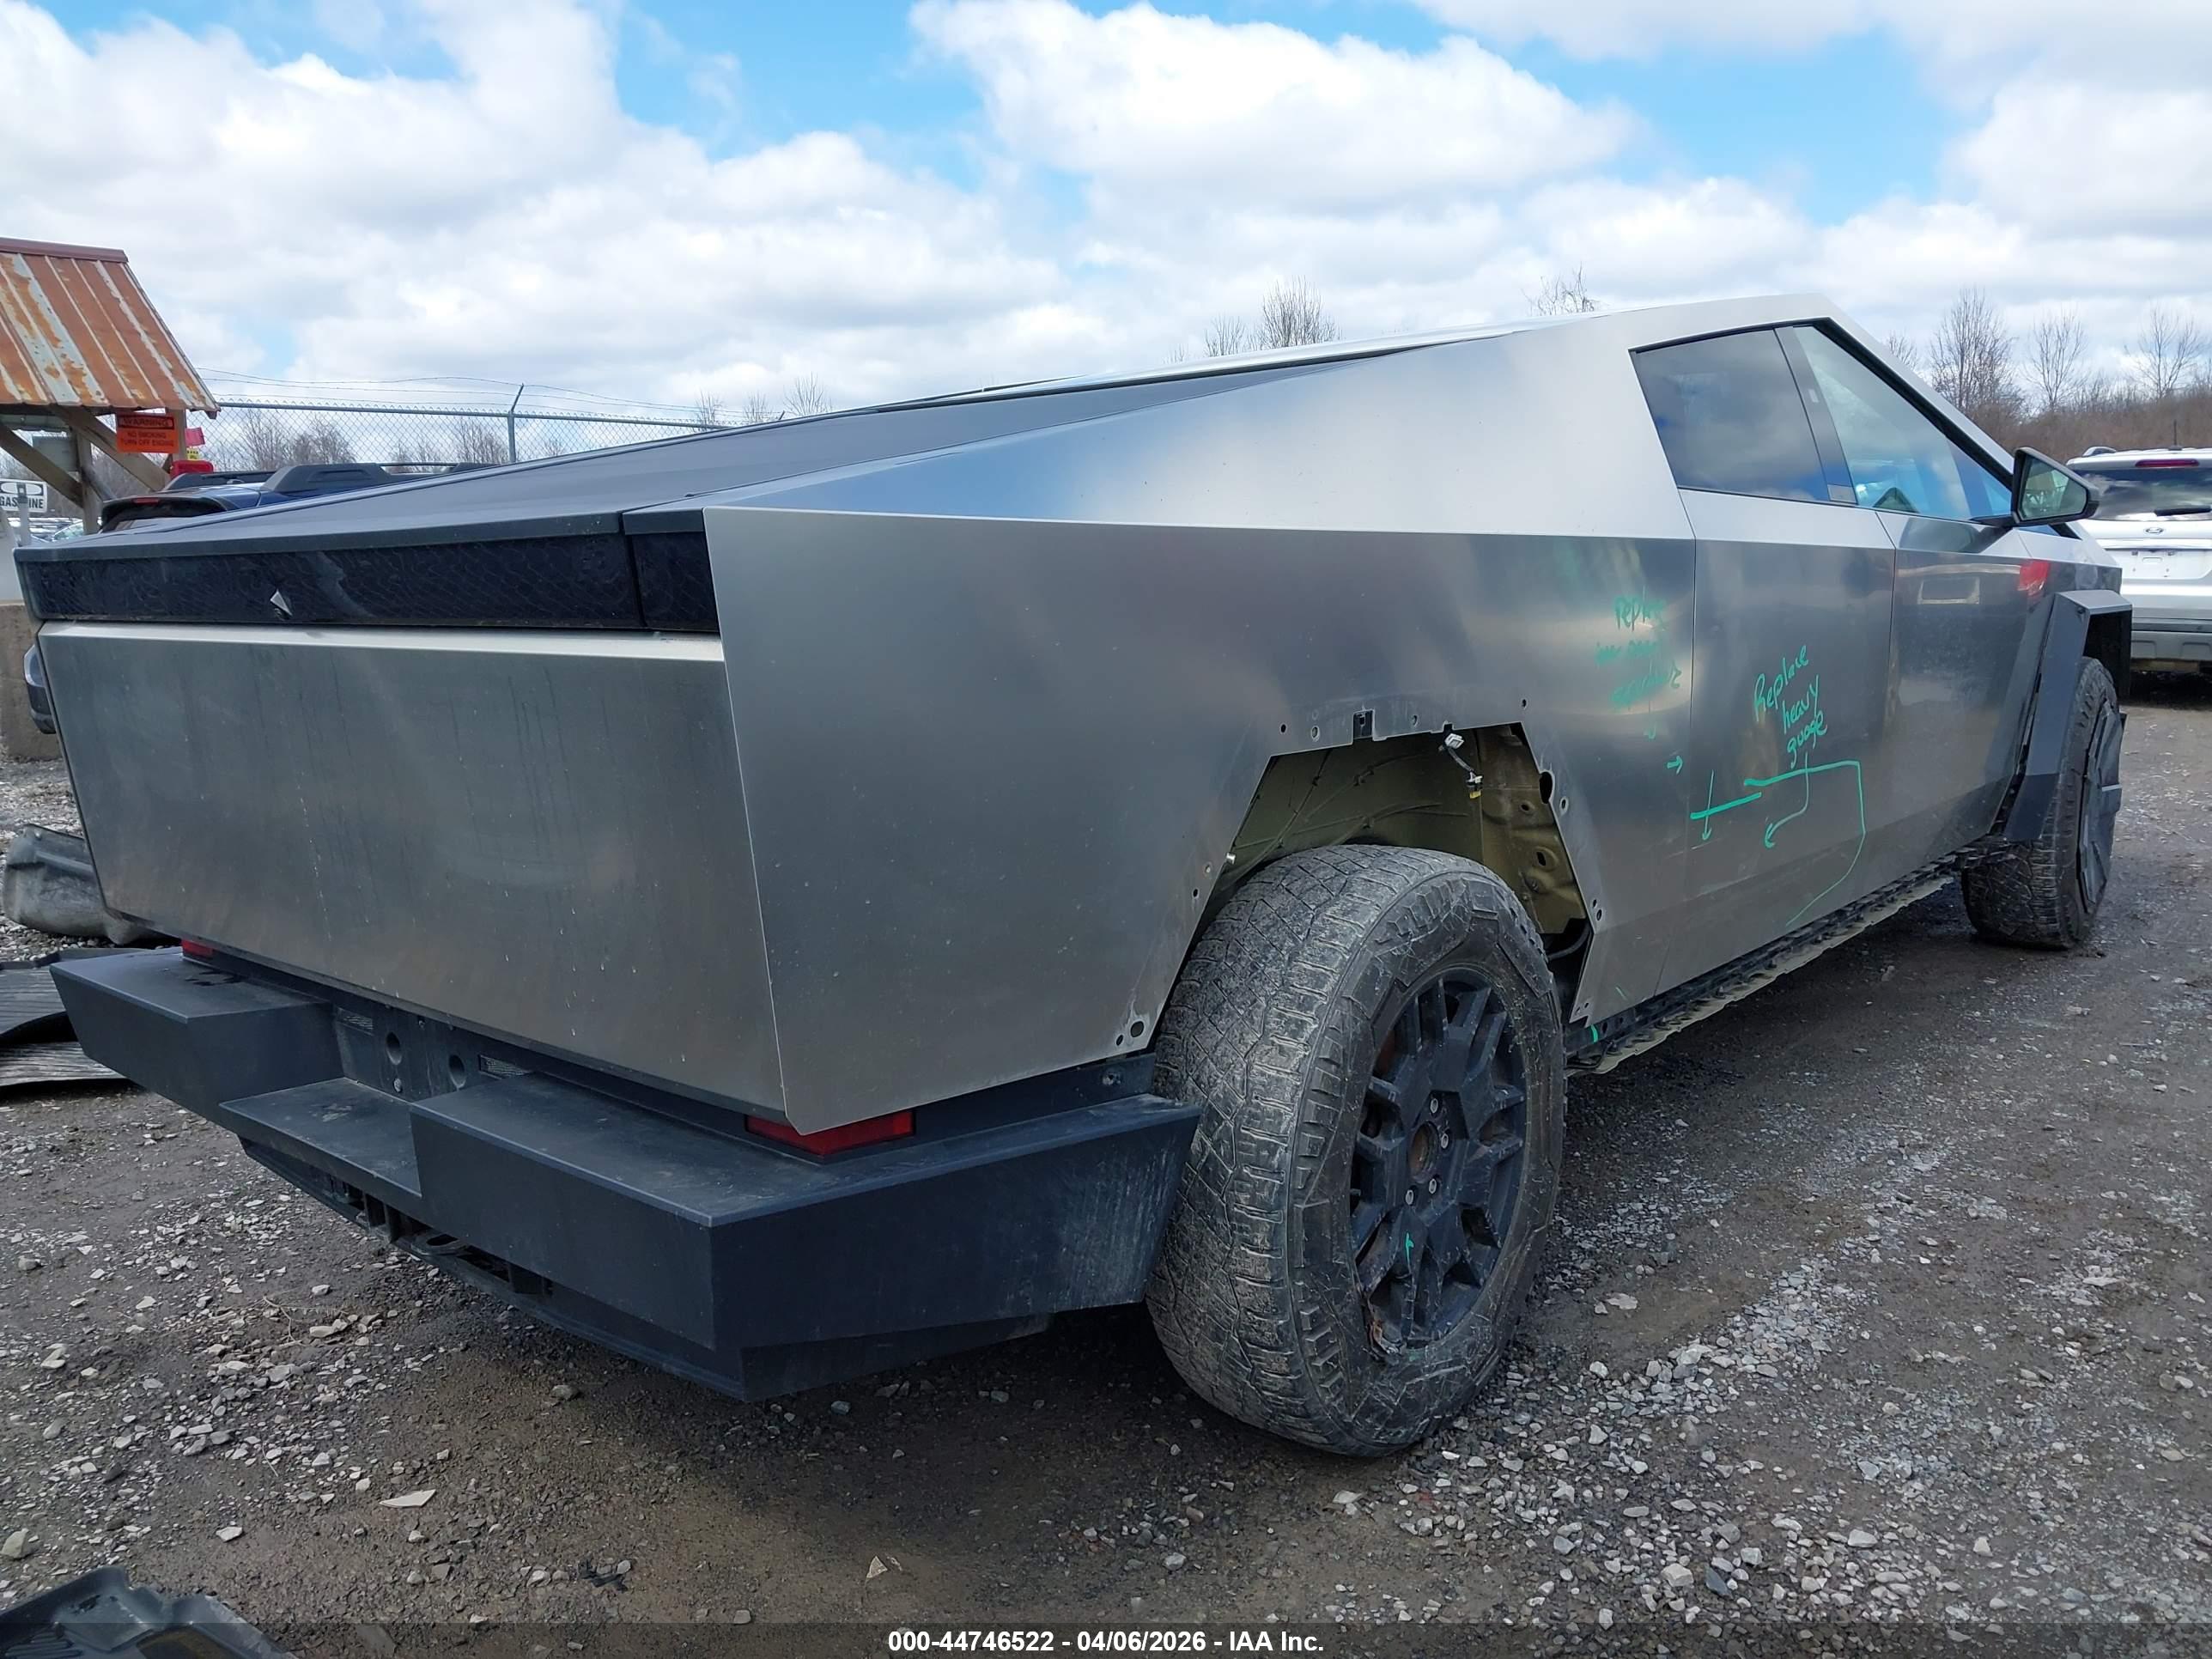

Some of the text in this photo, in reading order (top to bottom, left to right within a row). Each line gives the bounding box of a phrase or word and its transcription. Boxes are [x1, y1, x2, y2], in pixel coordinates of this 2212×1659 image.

[123, 417, 168, 427] WARNING
[0, 495, 44, 508] GASINE
[1753, 645, 1808, 721] Replace
[1782, 674, 1819, 734] heavy
